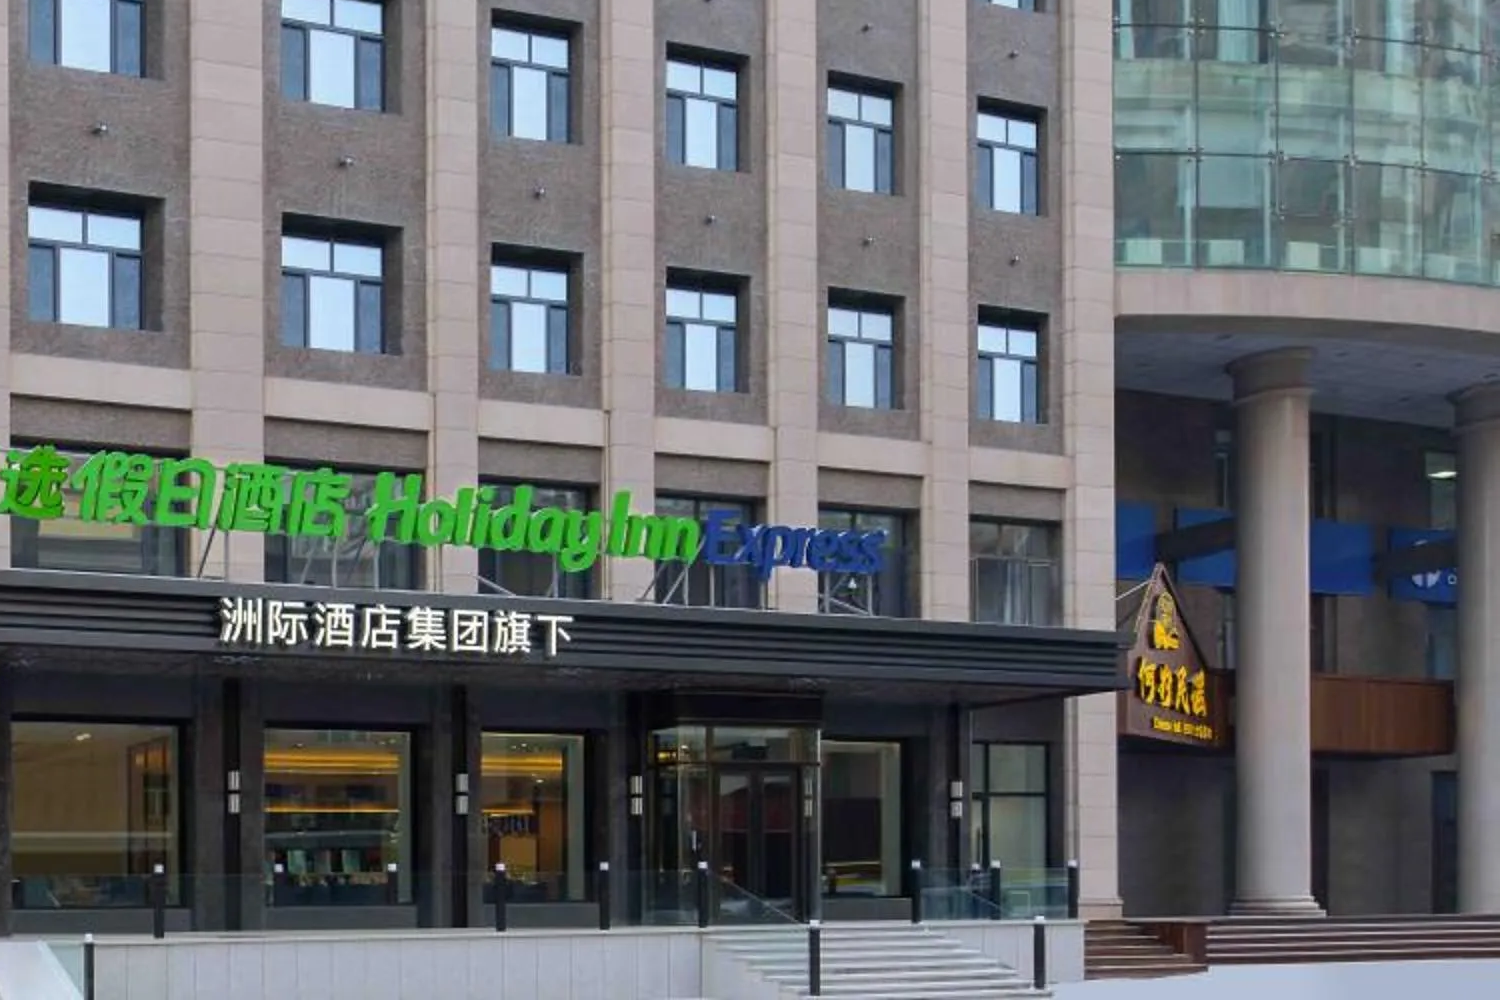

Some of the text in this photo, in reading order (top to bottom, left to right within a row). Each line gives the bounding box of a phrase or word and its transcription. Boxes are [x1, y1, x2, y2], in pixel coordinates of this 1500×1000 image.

[365, 472, 889, 581] Holiday Inn Express
[219, 597, 575, 657] 洲际酒店集团旗下
